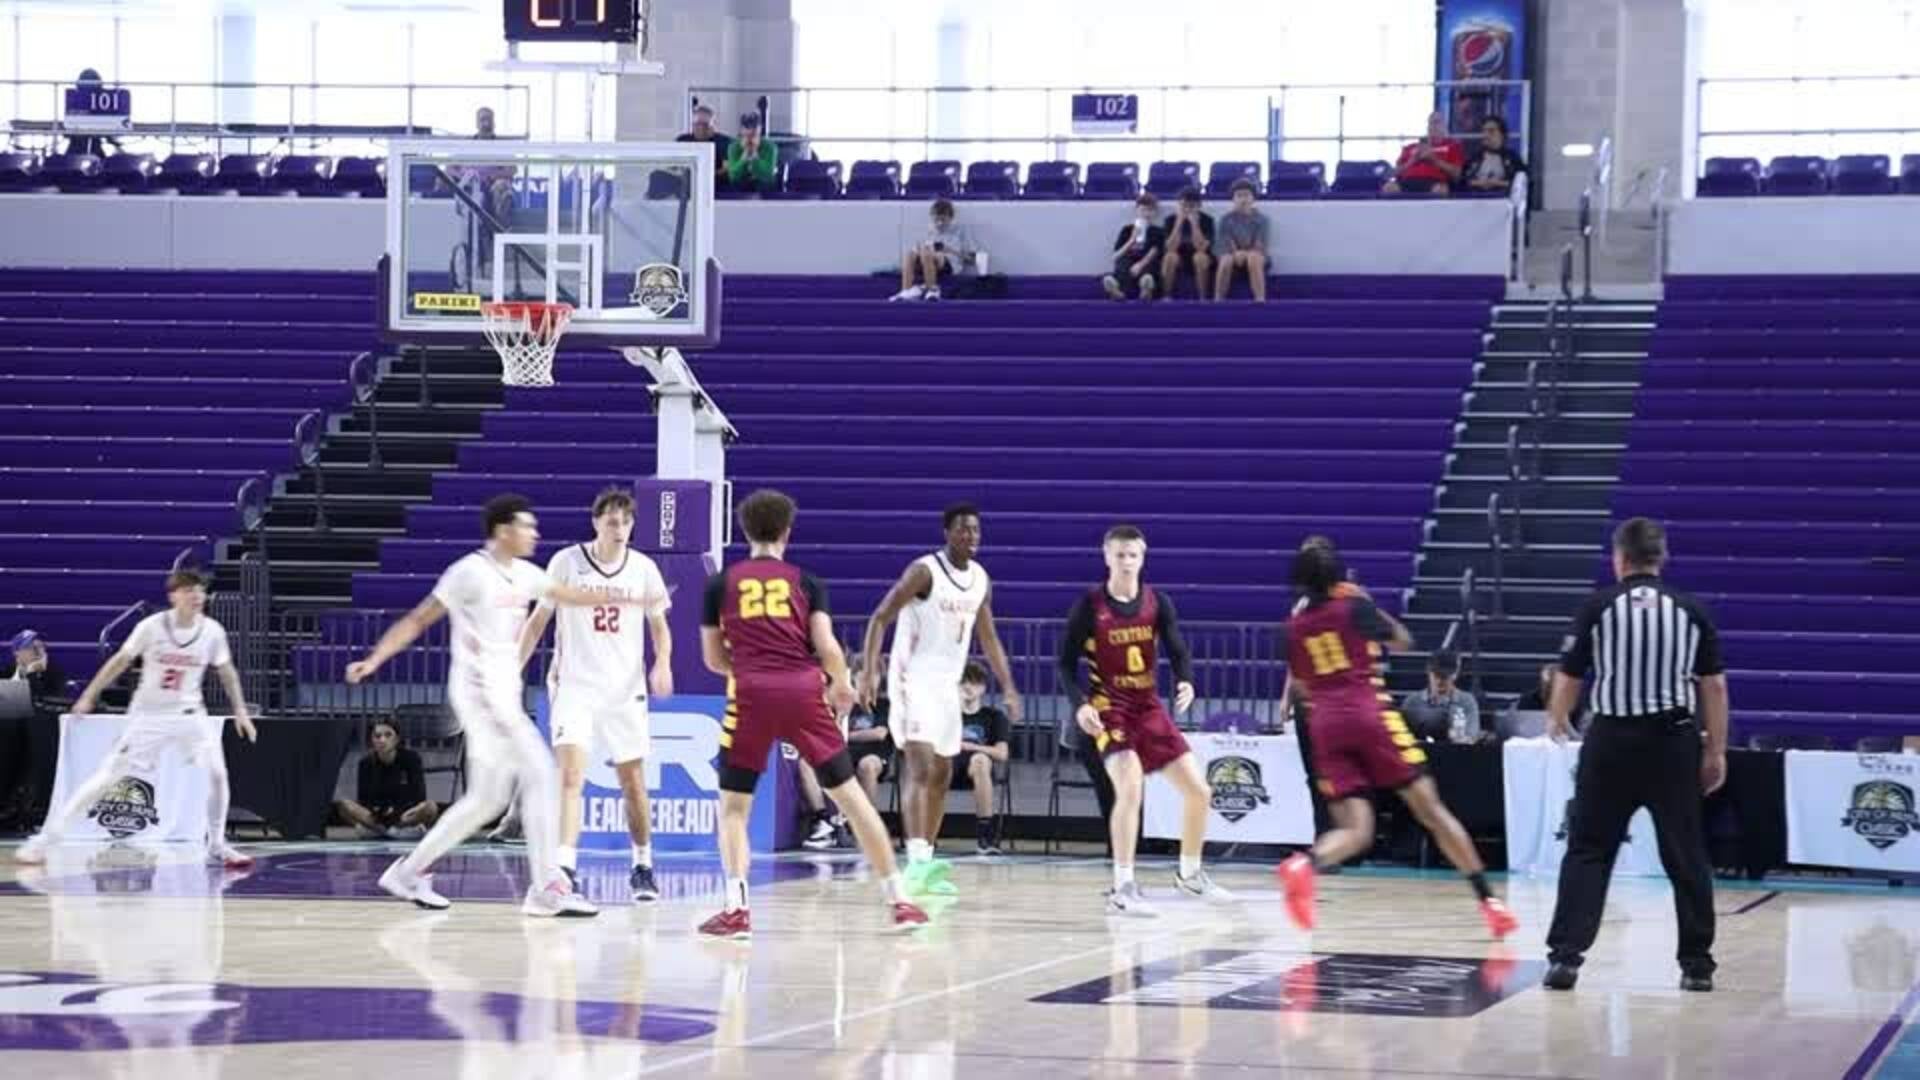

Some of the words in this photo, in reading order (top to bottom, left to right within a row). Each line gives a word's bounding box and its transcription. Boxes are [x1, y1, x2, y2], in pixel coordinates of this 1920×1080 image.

[90, 92, 119, 111] 101
[1096, 97, 1129, 116] 102
[418, 295, 477, 307] PANINI
[737, 578, 792, 619] 22
[593, 605, 621, 634] 22
[578, 797, 721, 835] LEAEREAD
